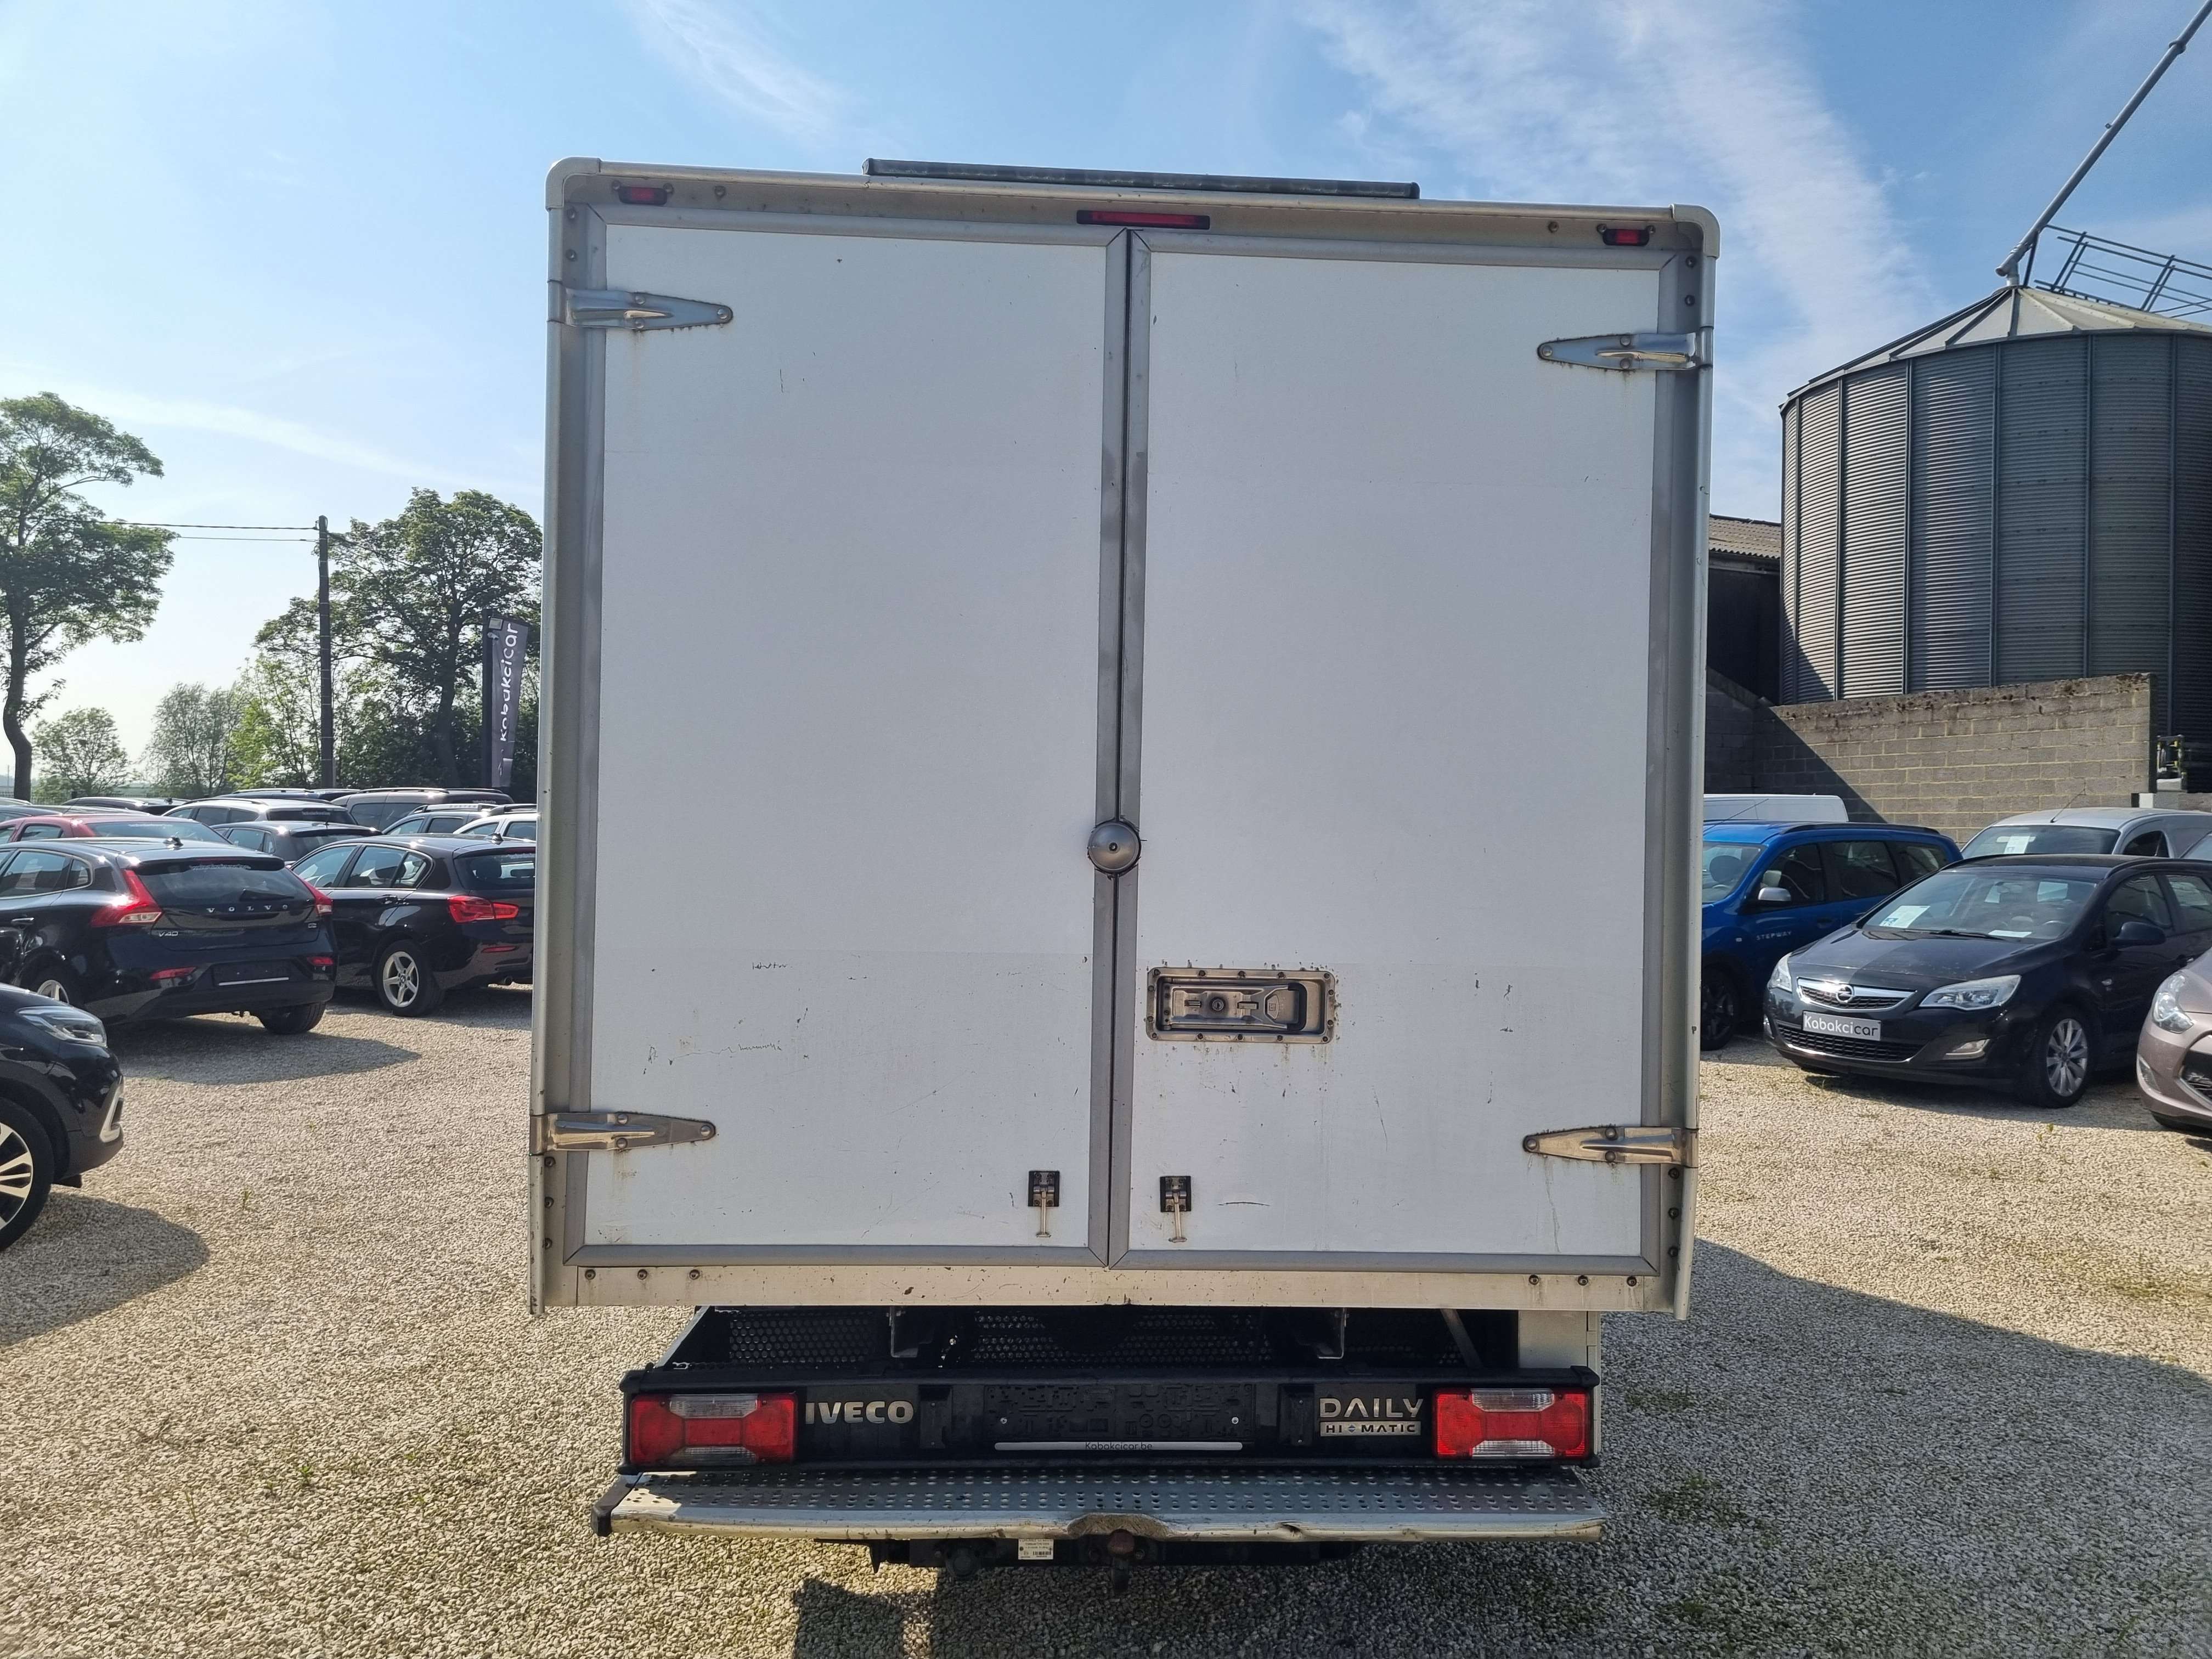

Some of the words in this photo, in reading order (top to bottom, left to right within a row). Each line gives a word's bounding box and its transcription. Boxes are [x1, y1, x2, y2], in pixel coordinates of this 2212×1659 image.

[206, 904, 288, 913] VOLVO
[1756, 930, 1792, 940] STEPWAY
[1804, 1015, 1878, 1036] Kabakcicar
[805, 1401, 914, 1424] IVECO
[1319, 1398, 1424, 1418] DAILY
[1085, 1441, 1153, 1450] Kabakcicar.be
